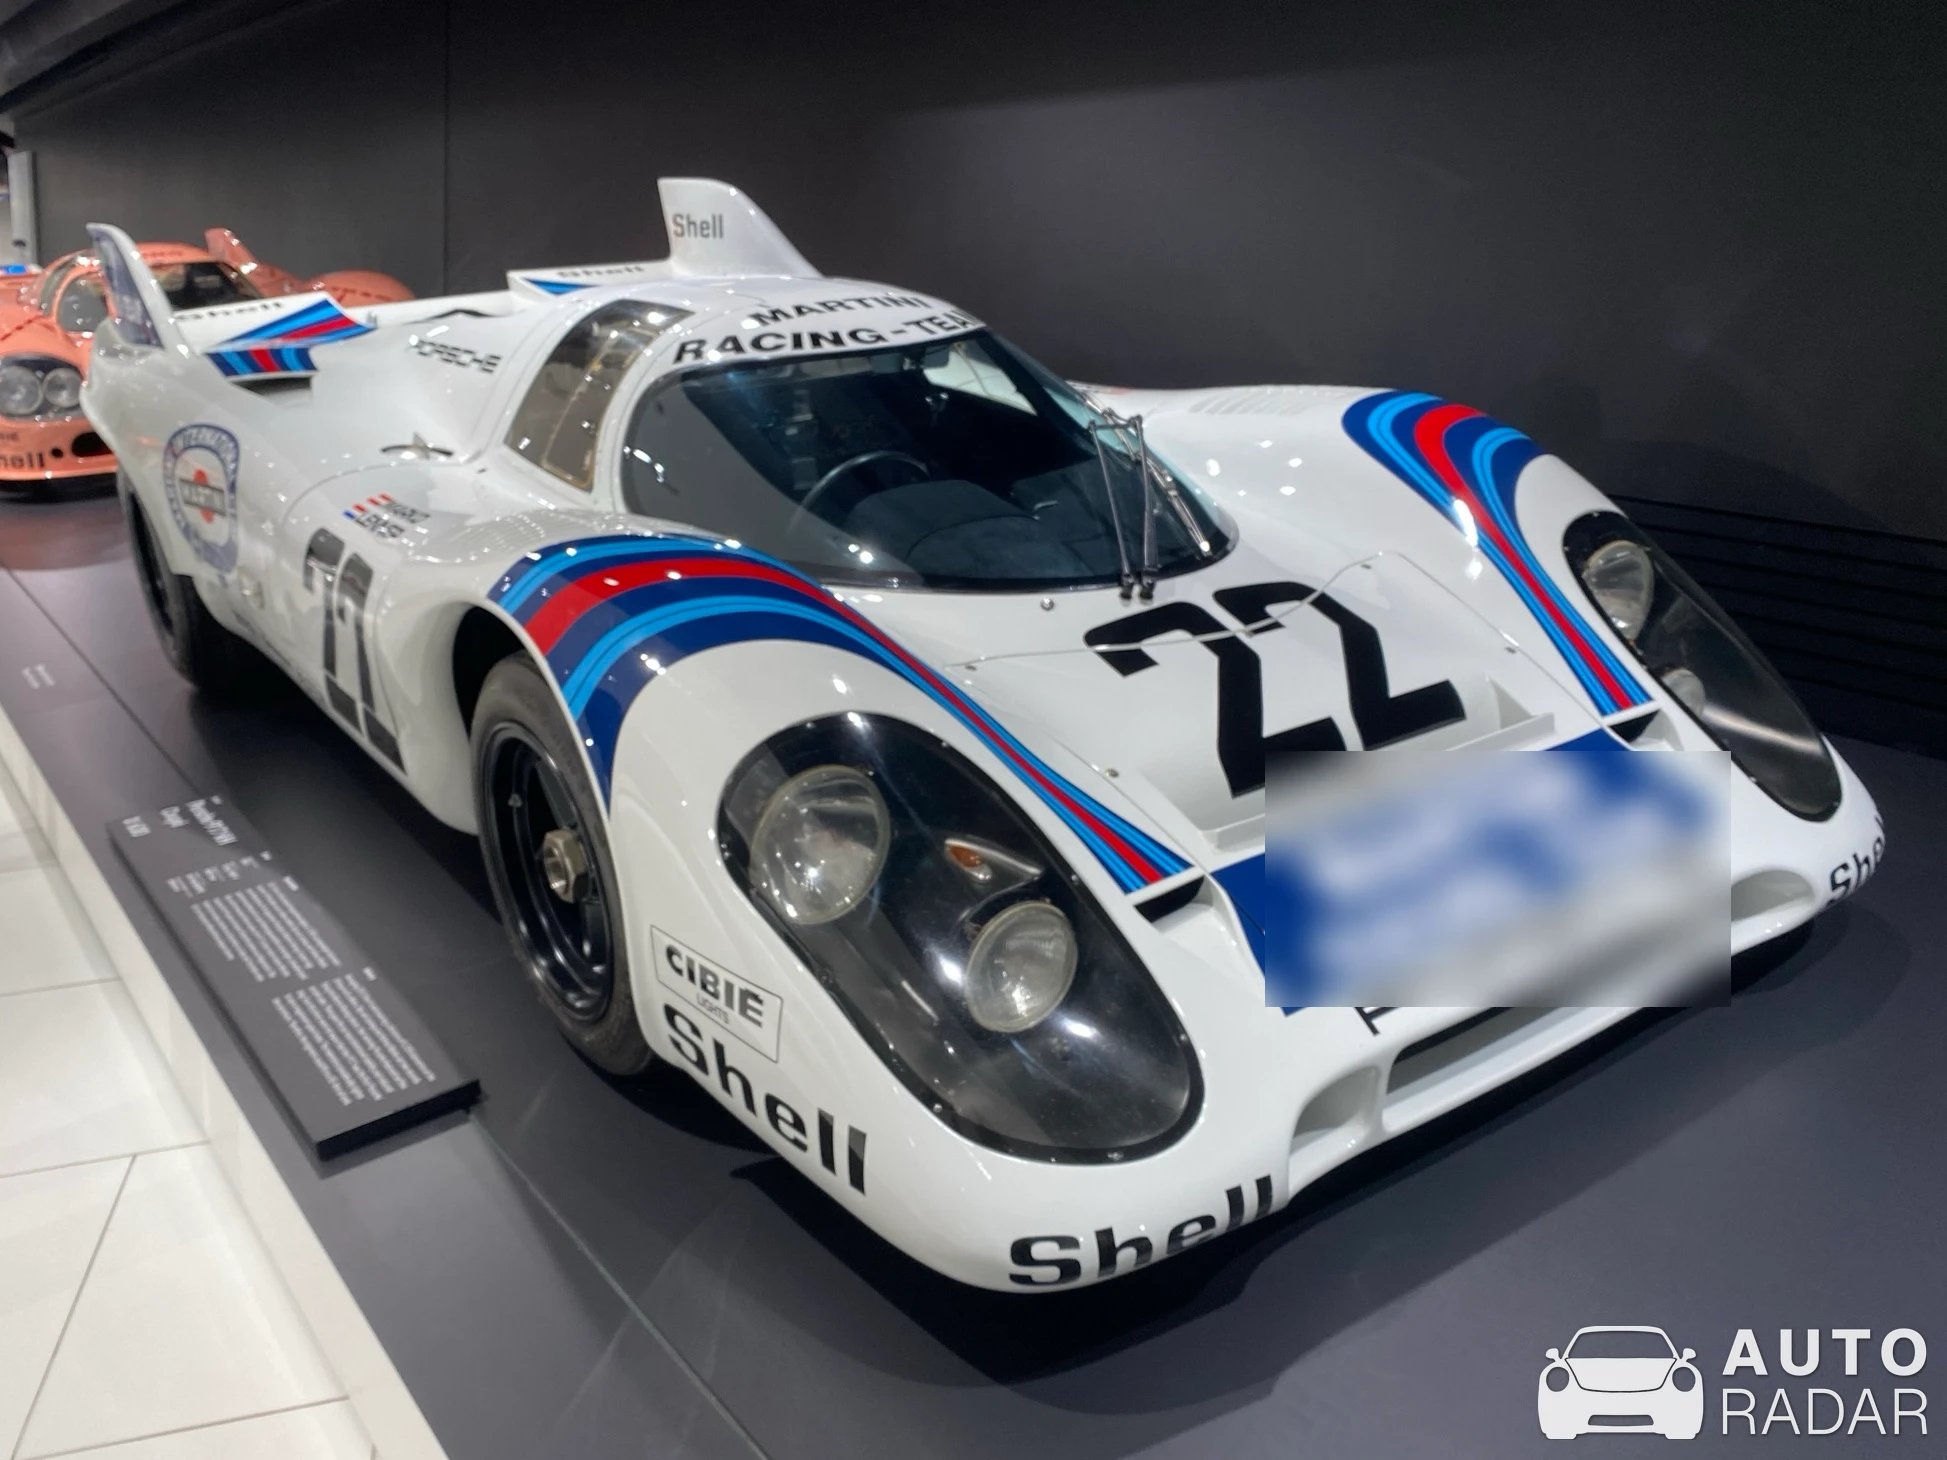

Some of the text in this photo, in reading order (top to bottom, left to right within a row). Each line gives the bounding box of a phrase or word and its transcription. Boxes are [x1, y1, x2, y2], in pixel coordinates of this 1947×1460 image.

[672, 213, 724, 239] Shell
[747, 296, 933, 327] MARTINI
[1083, 580, 1468, 799] 22
[663, 1002, 867, 1196] Shell
[1008, 1174, 1273, 1286] Shell
